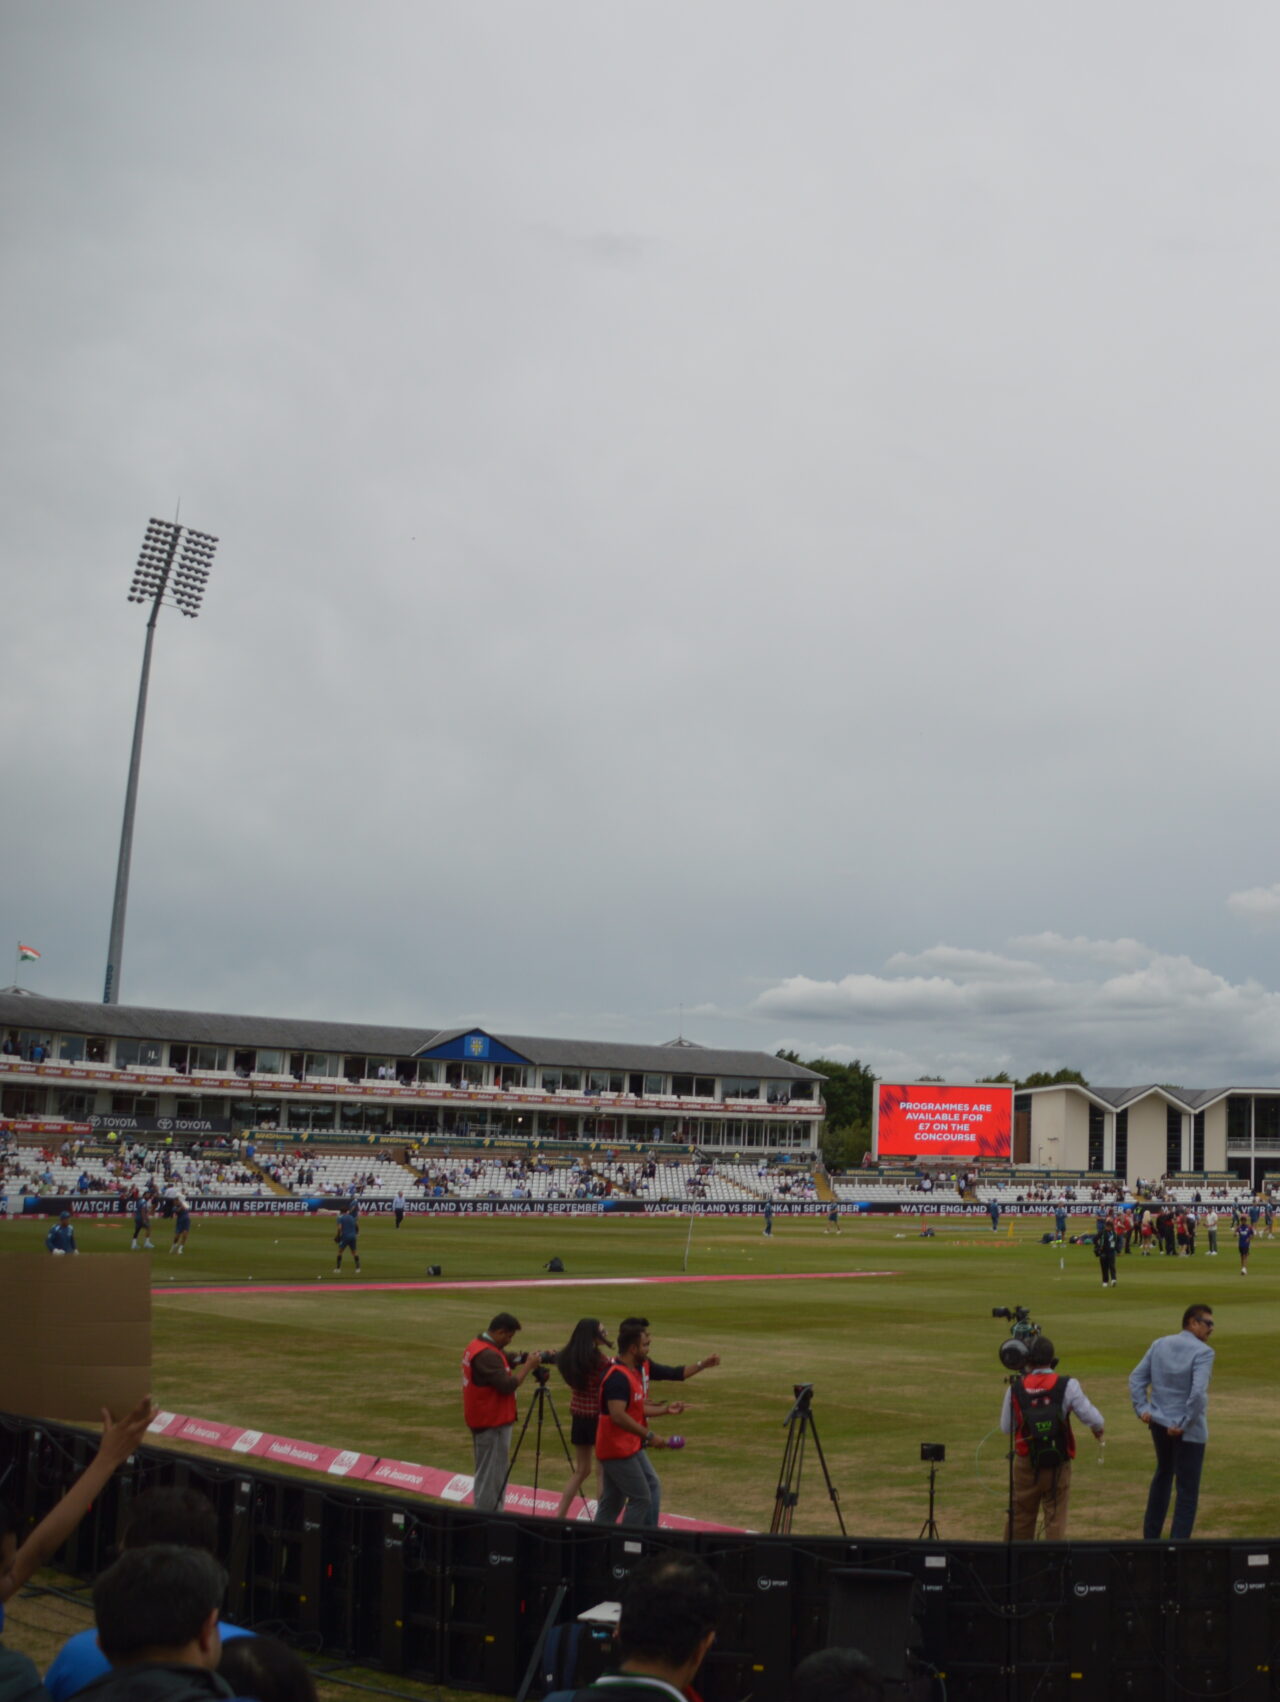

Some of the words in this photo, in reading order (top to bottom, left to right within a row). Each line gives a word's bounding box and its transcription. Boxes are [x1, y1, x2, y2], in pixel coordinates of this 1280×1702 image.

[900, 1102, 970, 1112] PROGRAMMES
[972, 1104, 992, 1112] ARE
[906, 1113, 959, 1121] AVAILABLE
[103, 1118, 138, 1128] TOYOTA
[175, 1120, 212, 1130] TOYOTA
[918, 1123, 930, 1131] £7
[933, 1123, 948, 1131] ON
[951, 1123, 970, 1131] THE
[914, 1133, 976, 1141] CONCOURSE
[72, 1201, 110, 1212] WATCH
[195, 1201, 227, 1211] LANKA
[229, 1201, 240, 1211] IN
[243, 1201, 309, 1211] SEPTEMBER
[357, 1202, 394, 1211] WATC
[404, 1202, 456, 1212] ENGLAND
[459, 1202, 473, 1211] VS
[476, 1202, 492, 1212] SRI
[495, 1202, 531, 1212] LANKA
[534, 1202, 544, 1212] IN
[547, 1203, 605, 1212] SEPTEMBER
[644, 1203, 679, 1212] WATCH
[682, 1204, 727, 1212] ENGLAND
[728, 1204, 740, 1212] VS
[742, 1204, 756, 1212] SRI
[791, 1204, 801, 1212] IN
[900, 1204, 937, 1213] WATCH
[940, 1204, 987, 1213] ENGLAND
[1005, 1205, 1020, 1213] SRI
[1022, 1205, 1055, 1213] LANKA
[390, 1470, 423, 1484] insurance
[519, 1496, 560, 1510] insurance
